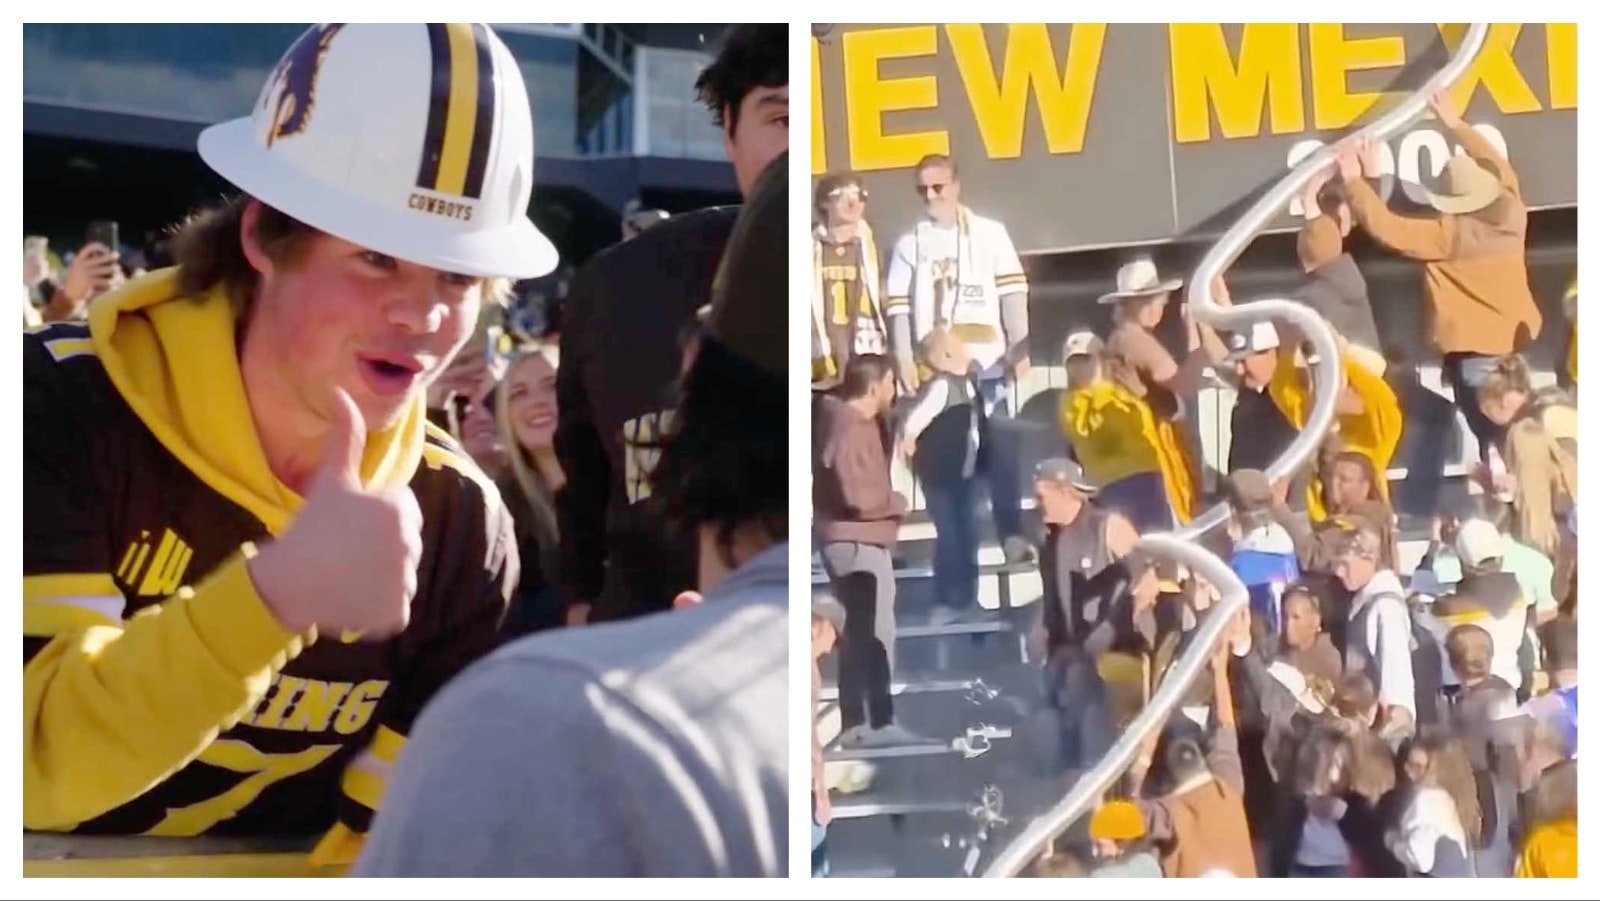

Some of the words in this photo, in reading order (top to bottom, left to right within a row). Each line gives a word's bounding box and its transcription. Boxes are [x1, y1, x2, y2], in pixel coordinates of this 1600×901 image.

[811, 23, 1107, 175] EW
[408, 193, 473, 221] COWBOYS
[237, 672, 390, 735] ING
